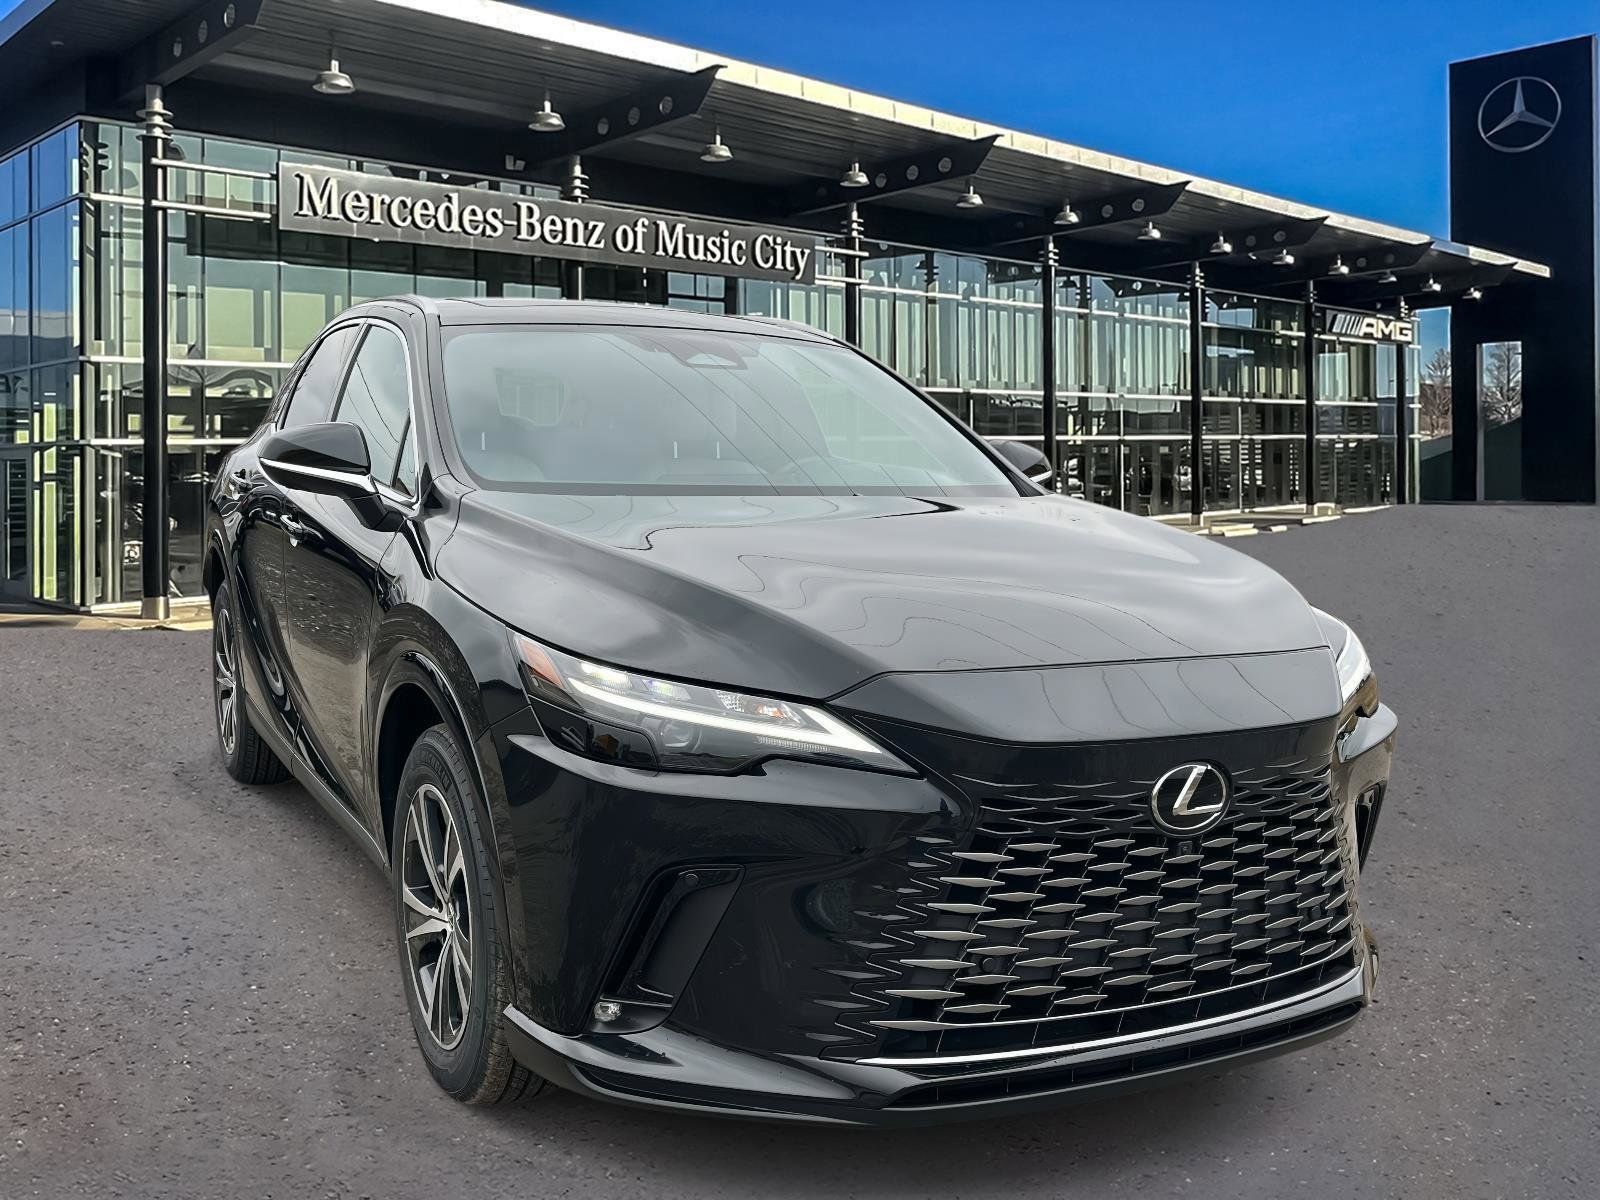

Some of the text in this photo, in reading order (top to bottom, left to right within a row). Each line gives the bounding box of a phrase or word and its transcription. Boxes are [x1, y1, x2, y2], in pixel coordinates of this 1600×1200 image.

[295, 172, 811, 280] Mercedes-Benz of Music City
[1358, 317, 1412, 342] AMG
